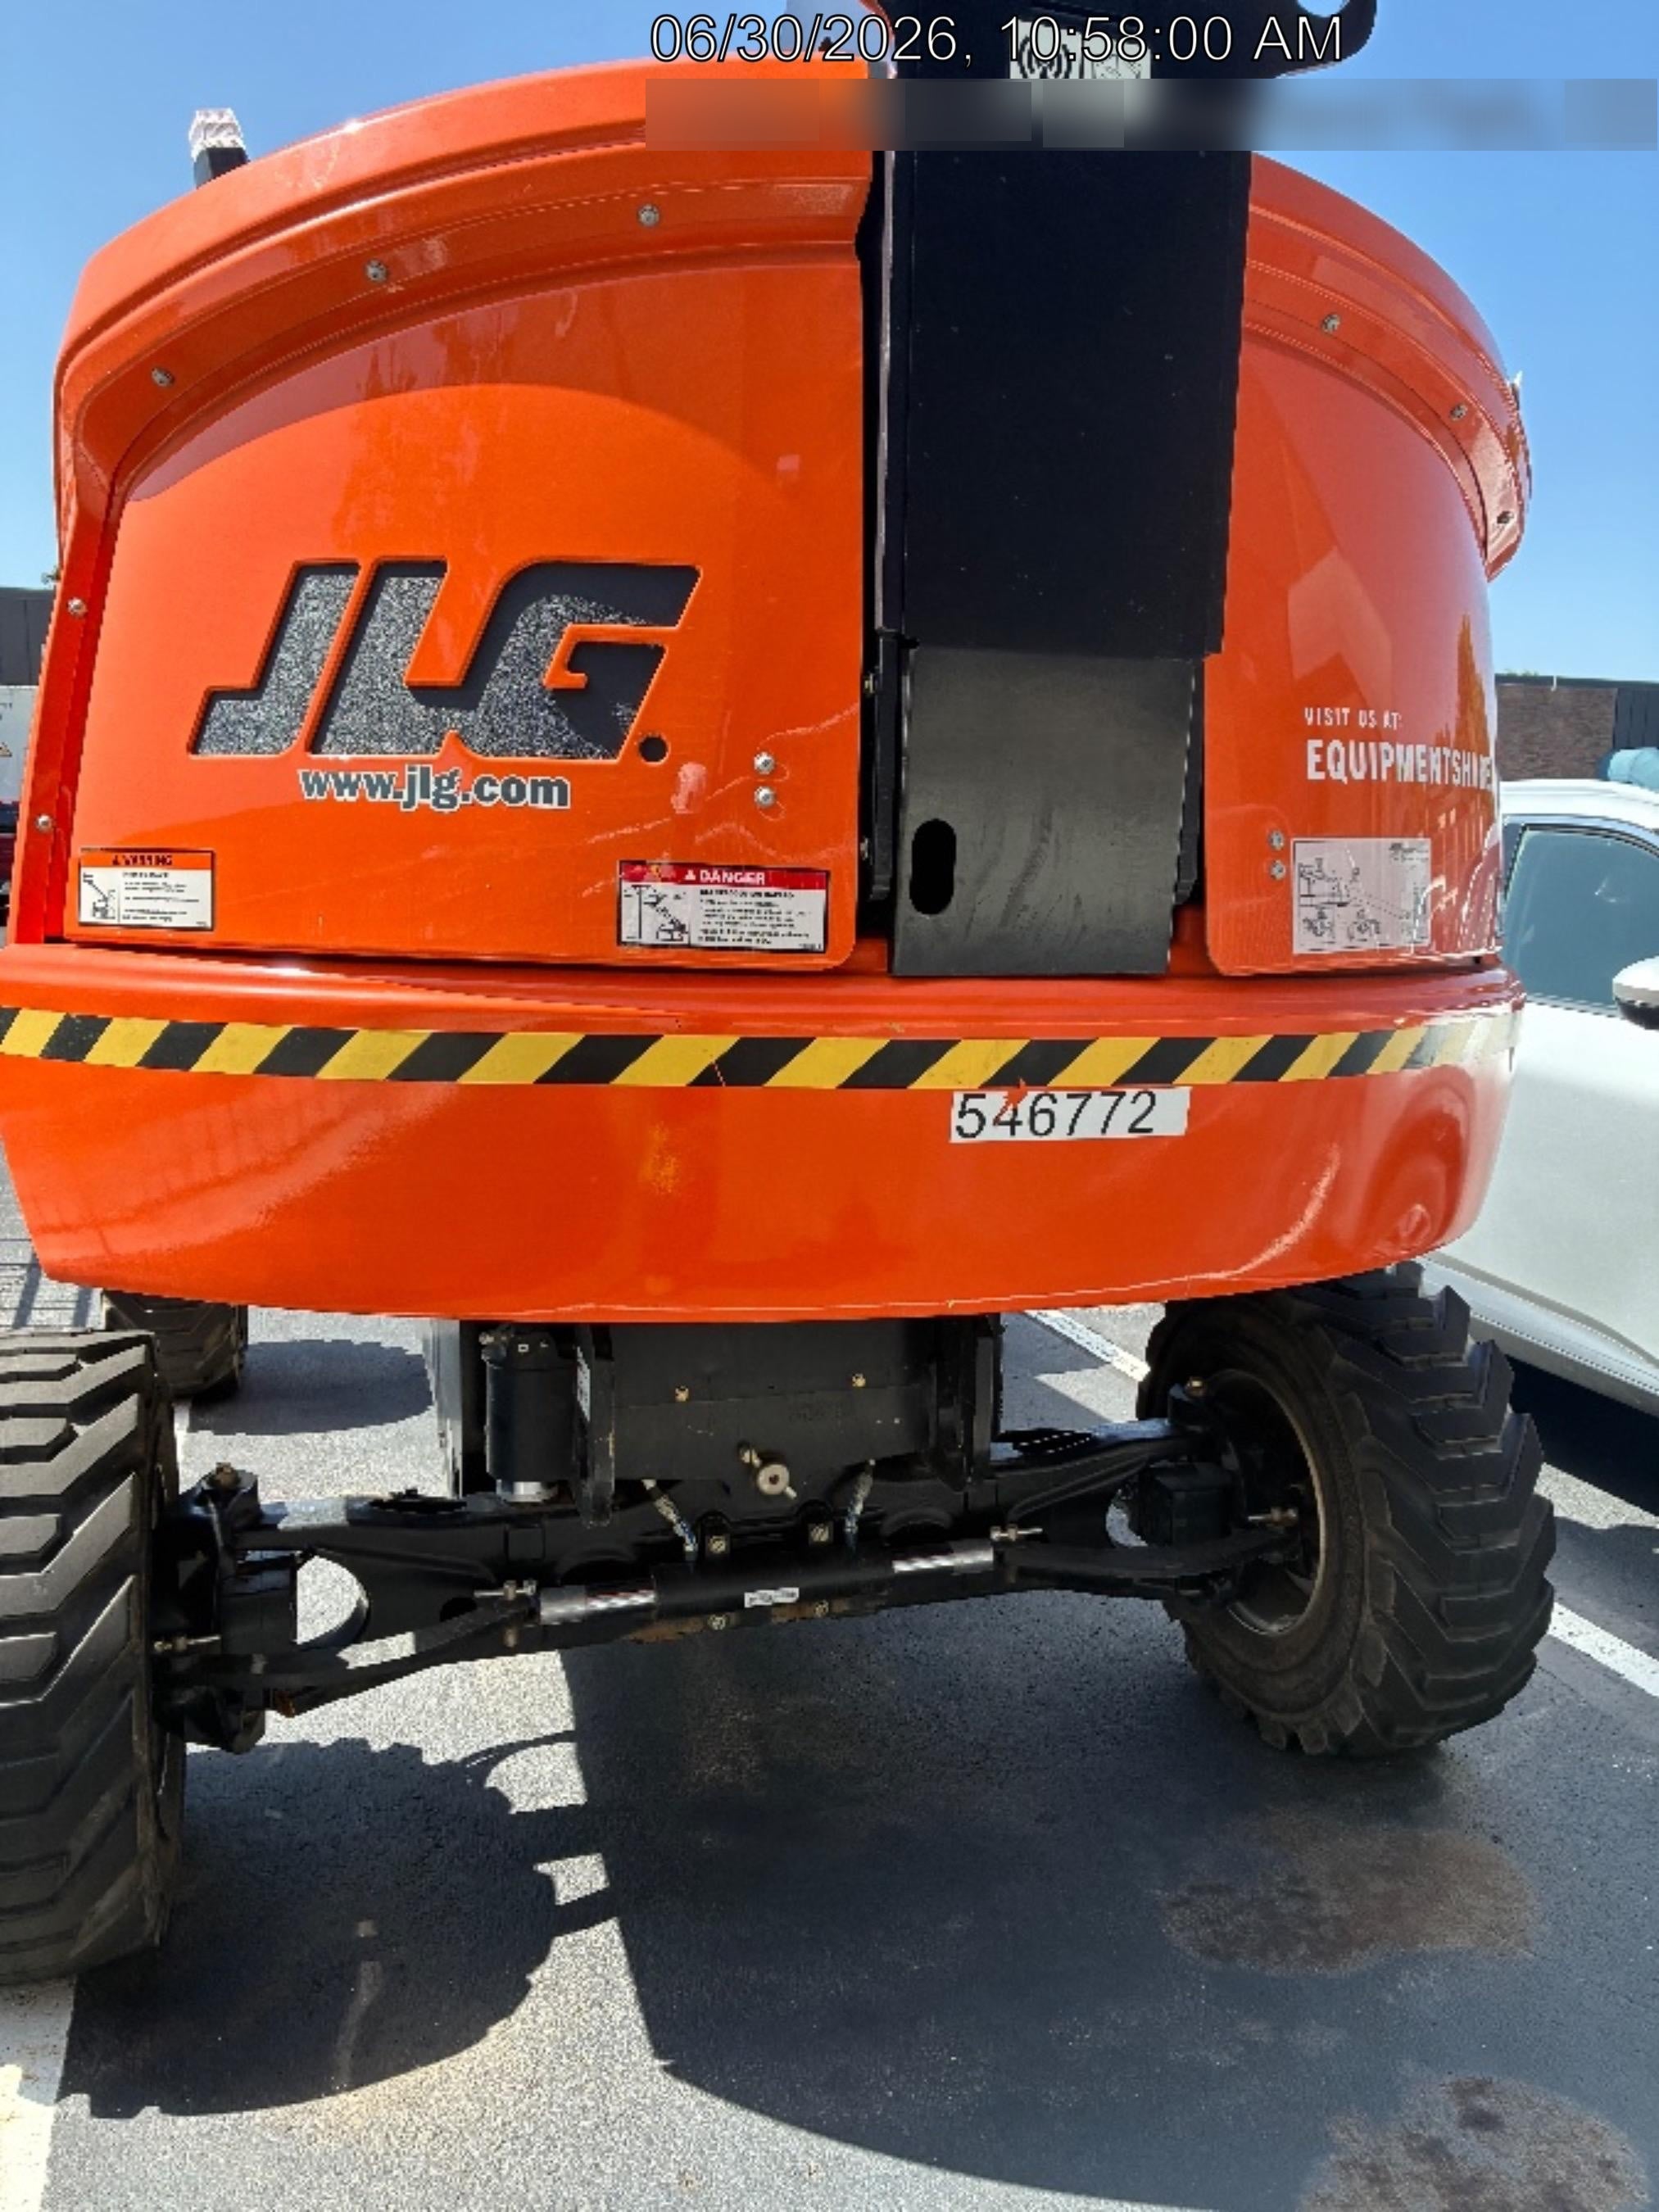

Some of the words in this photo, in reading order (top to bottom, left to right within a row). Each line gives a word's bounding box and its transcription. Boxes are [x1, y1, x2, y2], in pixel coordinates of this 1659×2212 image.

[1304, 706, 1351, 727] VISIT
[1358, 709, 1378, 728] US
[298, 764, 571, 812] www.jlg.com
[699, 868, 766, 886] DANGER
[955, 1090, 1157, 1139] 546772
